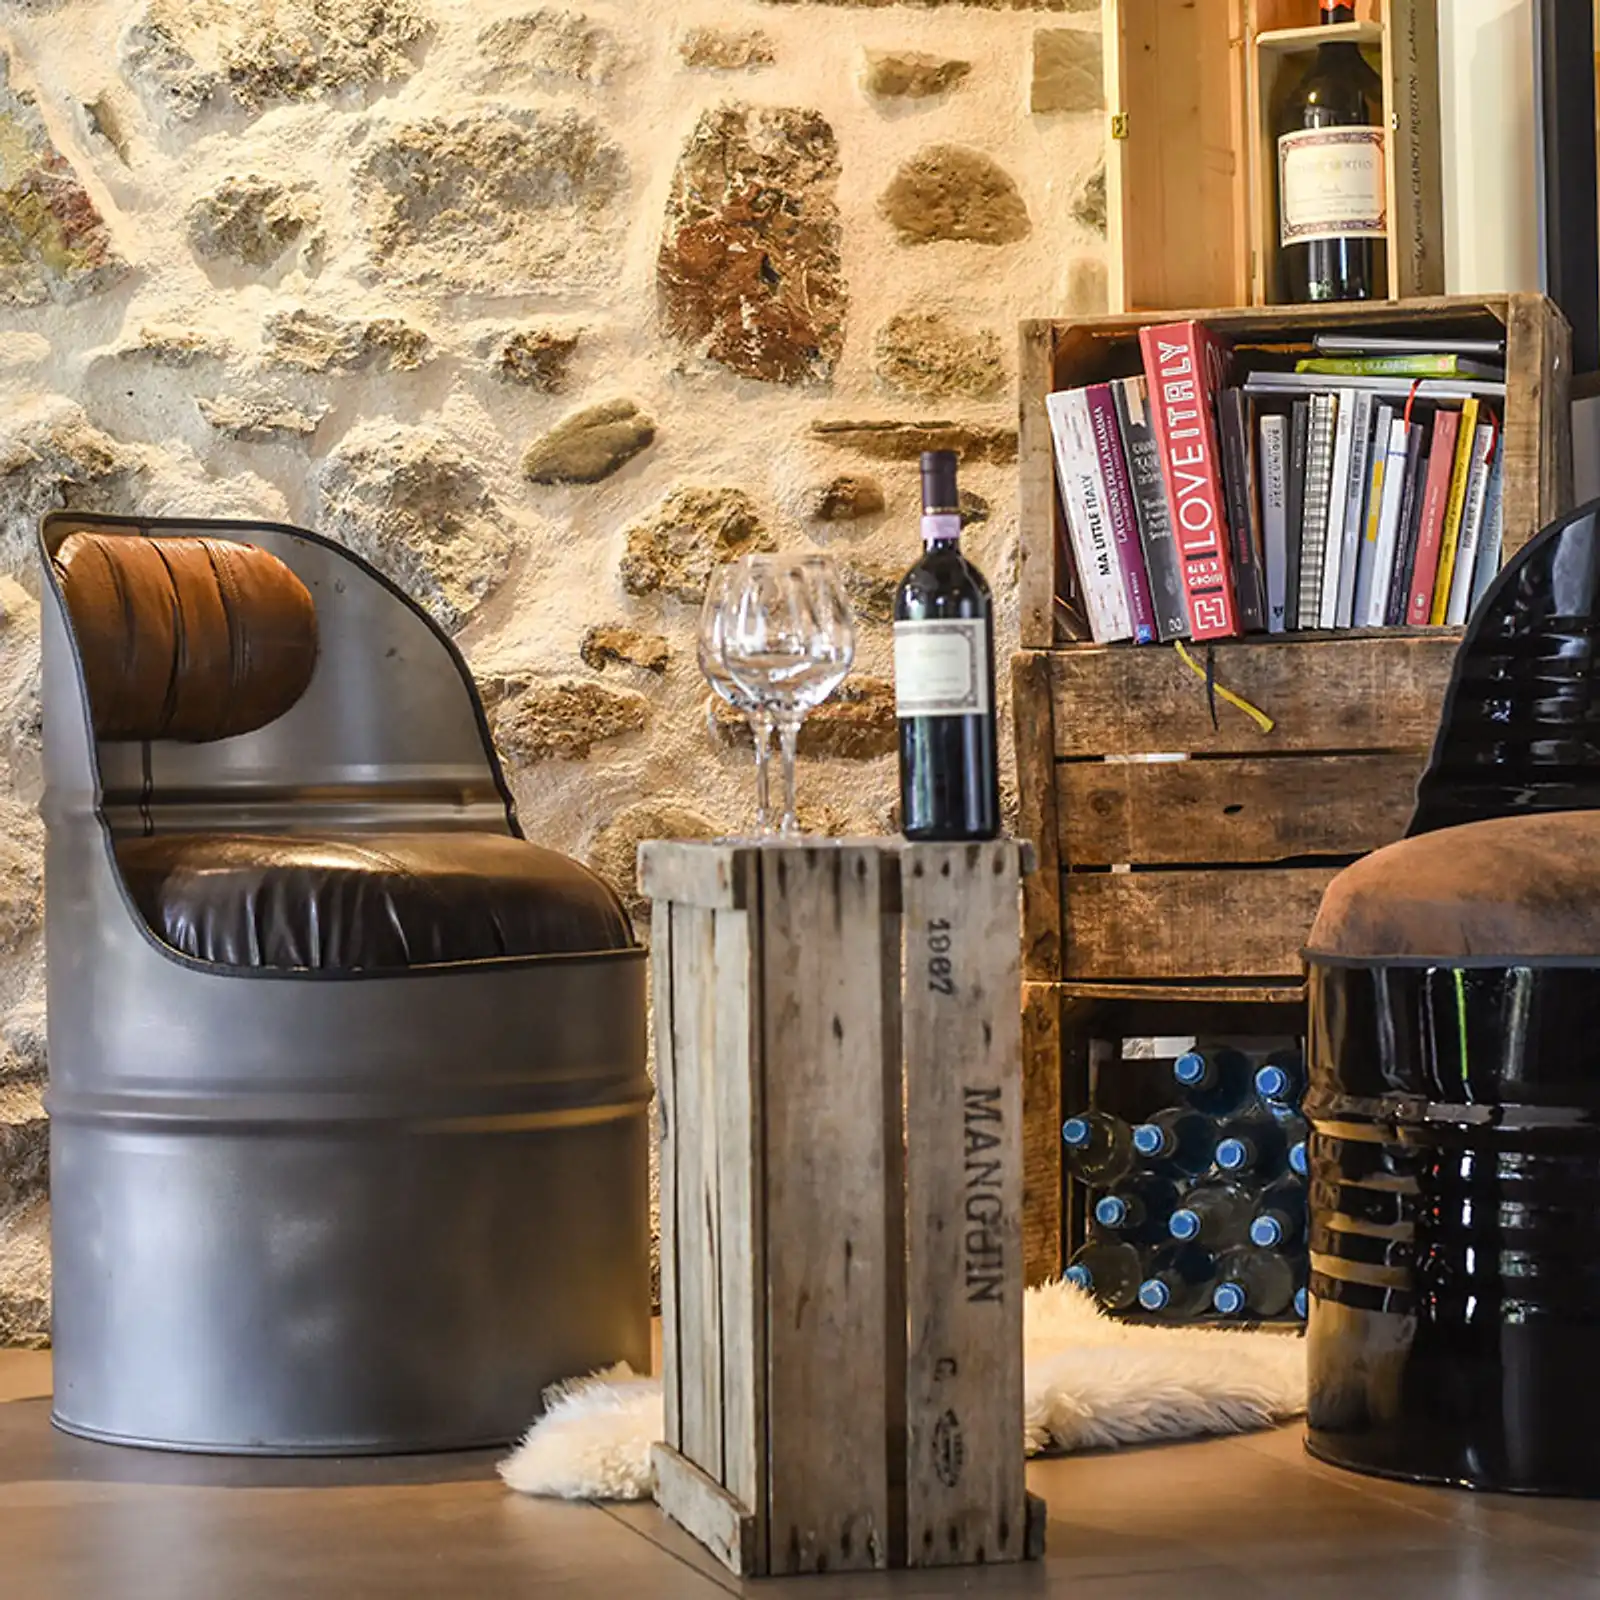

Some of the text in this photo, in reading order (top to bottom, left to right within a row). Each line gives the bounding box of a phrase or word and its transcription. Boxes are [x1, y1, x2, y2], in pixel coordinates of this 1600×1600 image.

[1156, 341, 1217, 550] LOVE ITALY
[1080, 475, 1112, 576] MA LITTLE ITALY
